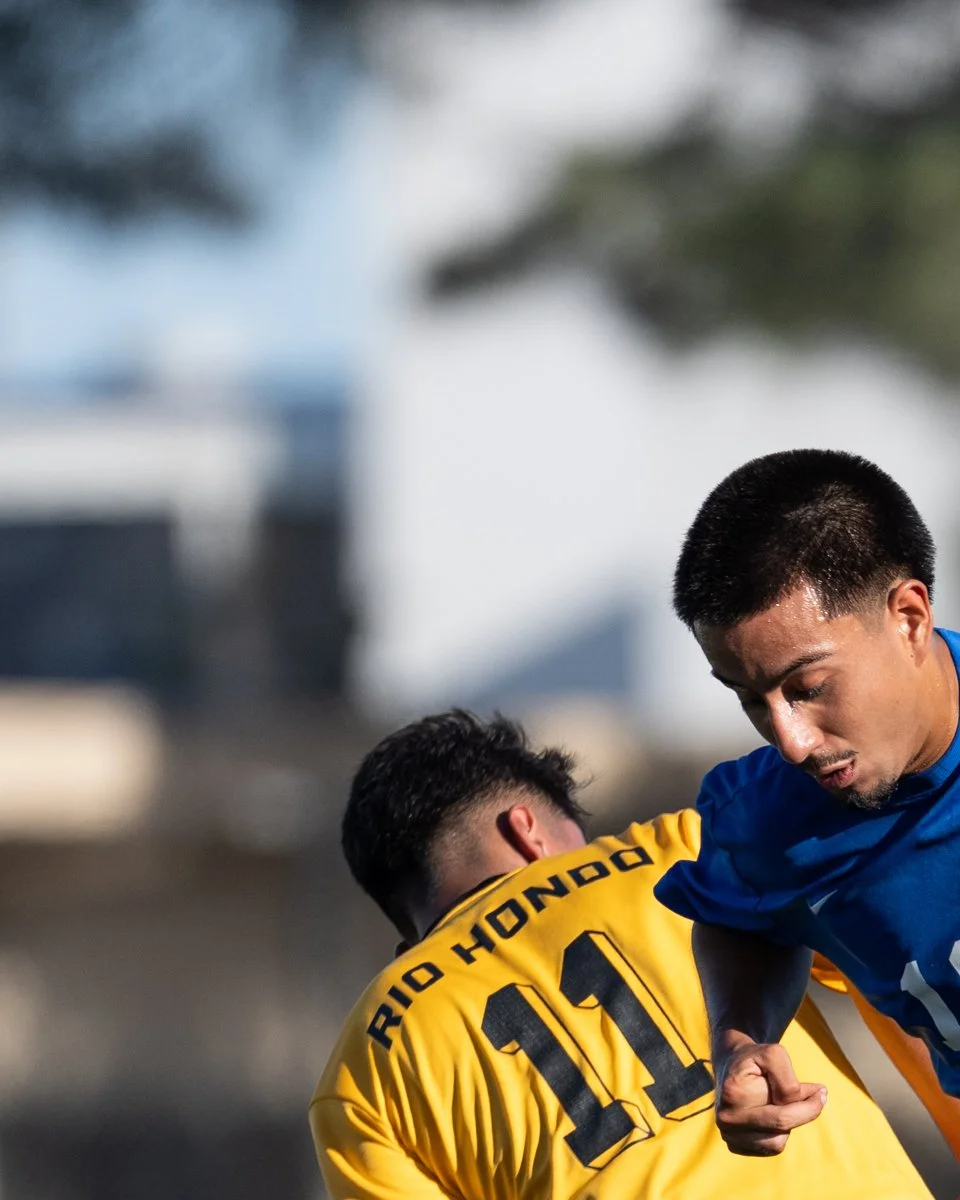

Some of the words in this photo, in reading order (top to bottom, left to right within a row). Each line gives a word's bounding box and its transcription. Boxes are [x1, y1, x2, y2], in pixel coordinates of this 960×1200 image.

[367, 961, 444, 1051] RIO
[451, 846, 655, 965] HONDO
[481, 930, 715, 1170] 11
